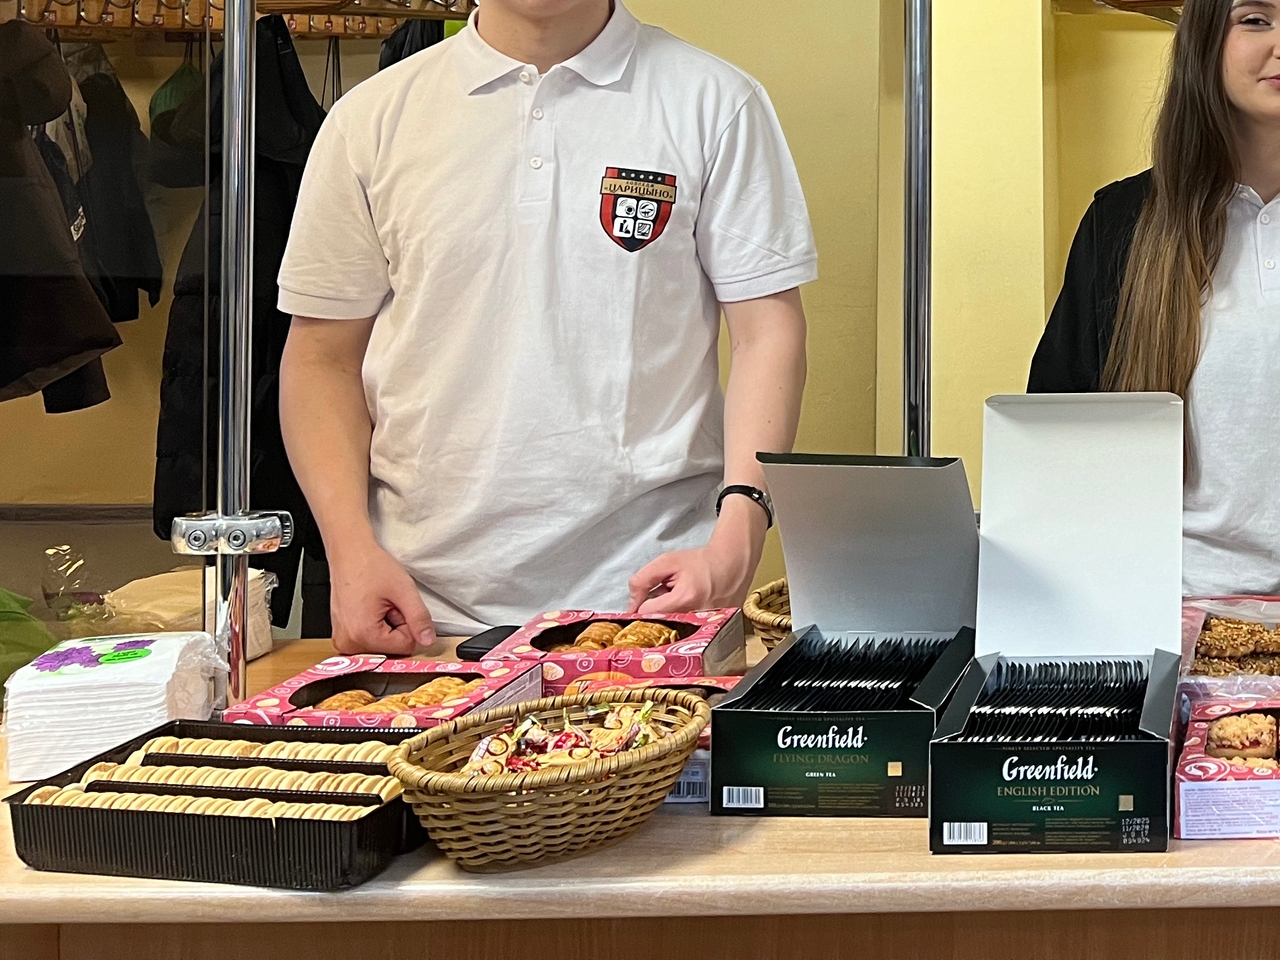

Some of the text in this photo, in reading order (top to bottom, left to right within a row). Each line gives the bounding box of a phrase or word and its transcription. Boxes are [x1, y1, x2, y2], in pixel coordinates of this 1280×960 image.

[777, 725, 867, 749] Greenfield
[773, 753, 869, 764] FLYING DRAGON
[1002, 755, 1097, 781] Greenfield
[997, 784, 1100, 796] ENGLISH EDITION
